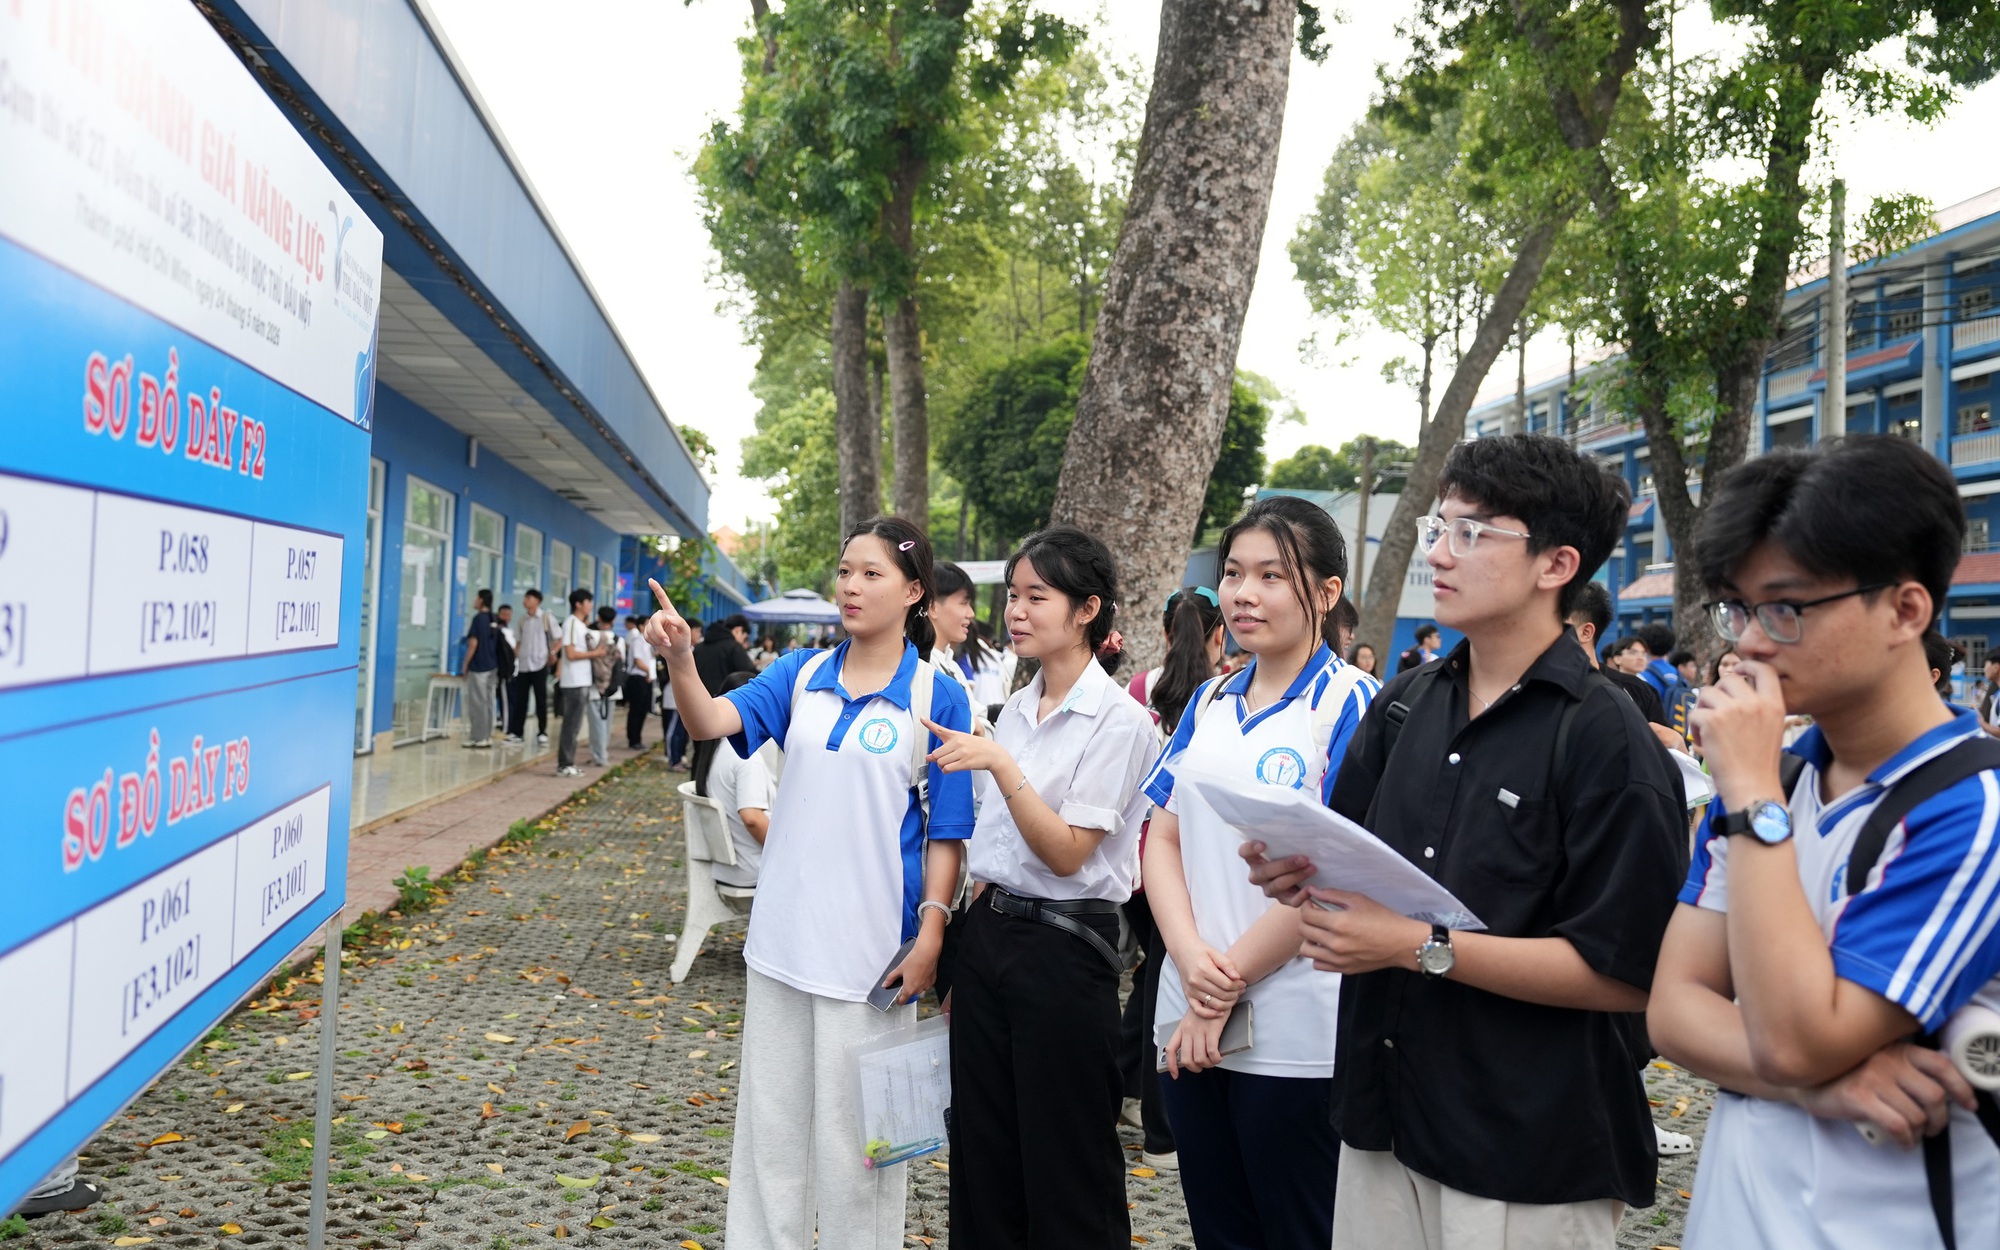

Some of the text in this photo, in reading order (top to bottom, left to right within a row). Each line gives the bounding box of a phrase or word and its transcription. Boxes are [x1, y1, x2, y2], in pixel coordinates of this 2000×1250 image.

[114, 36, 194, 166] ĐÁNH
[200, 120, 237, 206] GIÁ
[243, 159, 293, 255] NĂNG
[296, 212, 326, 286] LỰC
[164, 187, 180, 229] số
[198, 209, 236, 270] TRƯỜNG
[235, 240, 252, 286] ĐẠI
[251, 249, 268, 298] HỌC
[268, 264, 284, 308] THỦ
[298, 289, 313, 331] MỘT
[226, 295, 246, 333] tháng
[252, 311, 268, 339] năm
[84, 347, 265, 479] SƠ ĐỒ DÃY F2
[158, 529, 209, 573] P.058
[286, 546, 317, 580] P.057
[140, 601, 217, 653] [F2.102]
[275, 601, 321, 640] [F2.101]
[66, 729, 250, 870] SƠ ĐỒ DÃY F3
[273, 814, 303, 858] P.060
[140, 878, 191, 943] P.061
[261, 860, 307, 926] [F3.101]
[121, 934, 201, 1036] [F3.102]
